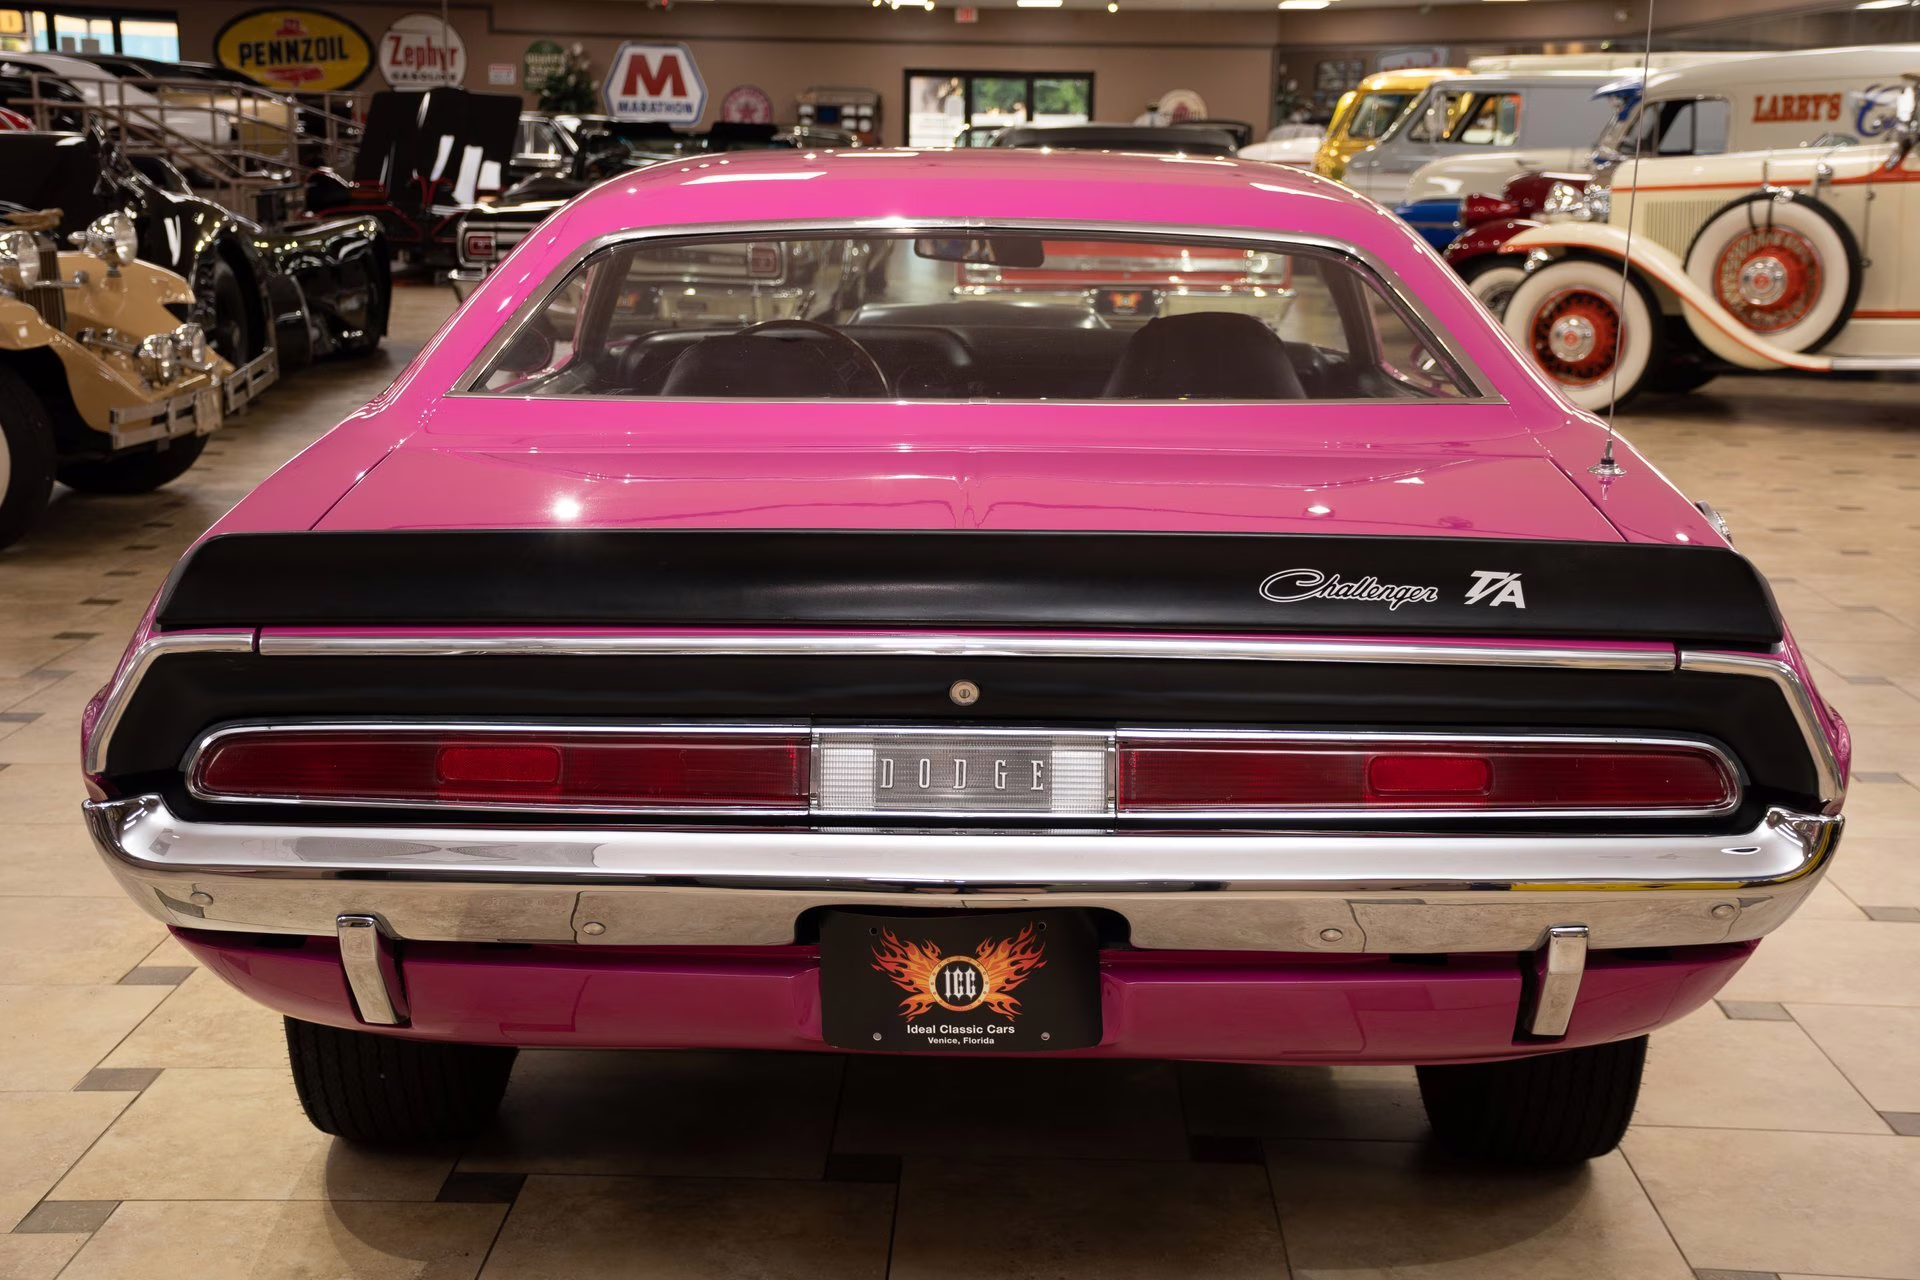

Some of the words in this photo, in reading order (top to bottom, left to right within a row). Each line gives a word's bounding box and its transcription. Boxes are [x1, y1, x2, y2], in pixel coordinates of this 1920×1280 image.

[239, 37, 349, 67] PENNZOIL
[388, 36, 460, 71] Zephyr
[621, 54, 688, 97] M
[617, 101, 694, 114] MARATHON
[1752, 92, 1843, 123] LARRY'S
[1259, 568, 1438, 611] Challenger
[880, 758, 1045, 791] DODGE
[906, 1024, 937, 1034] Ideal
[939, 1024, 984, 1035] Classic
[987, 1024, 1016, 1034] Cars
[927, 1036, 961, 1046] Venice,
[963, 1036, 995, 1045] Florida
